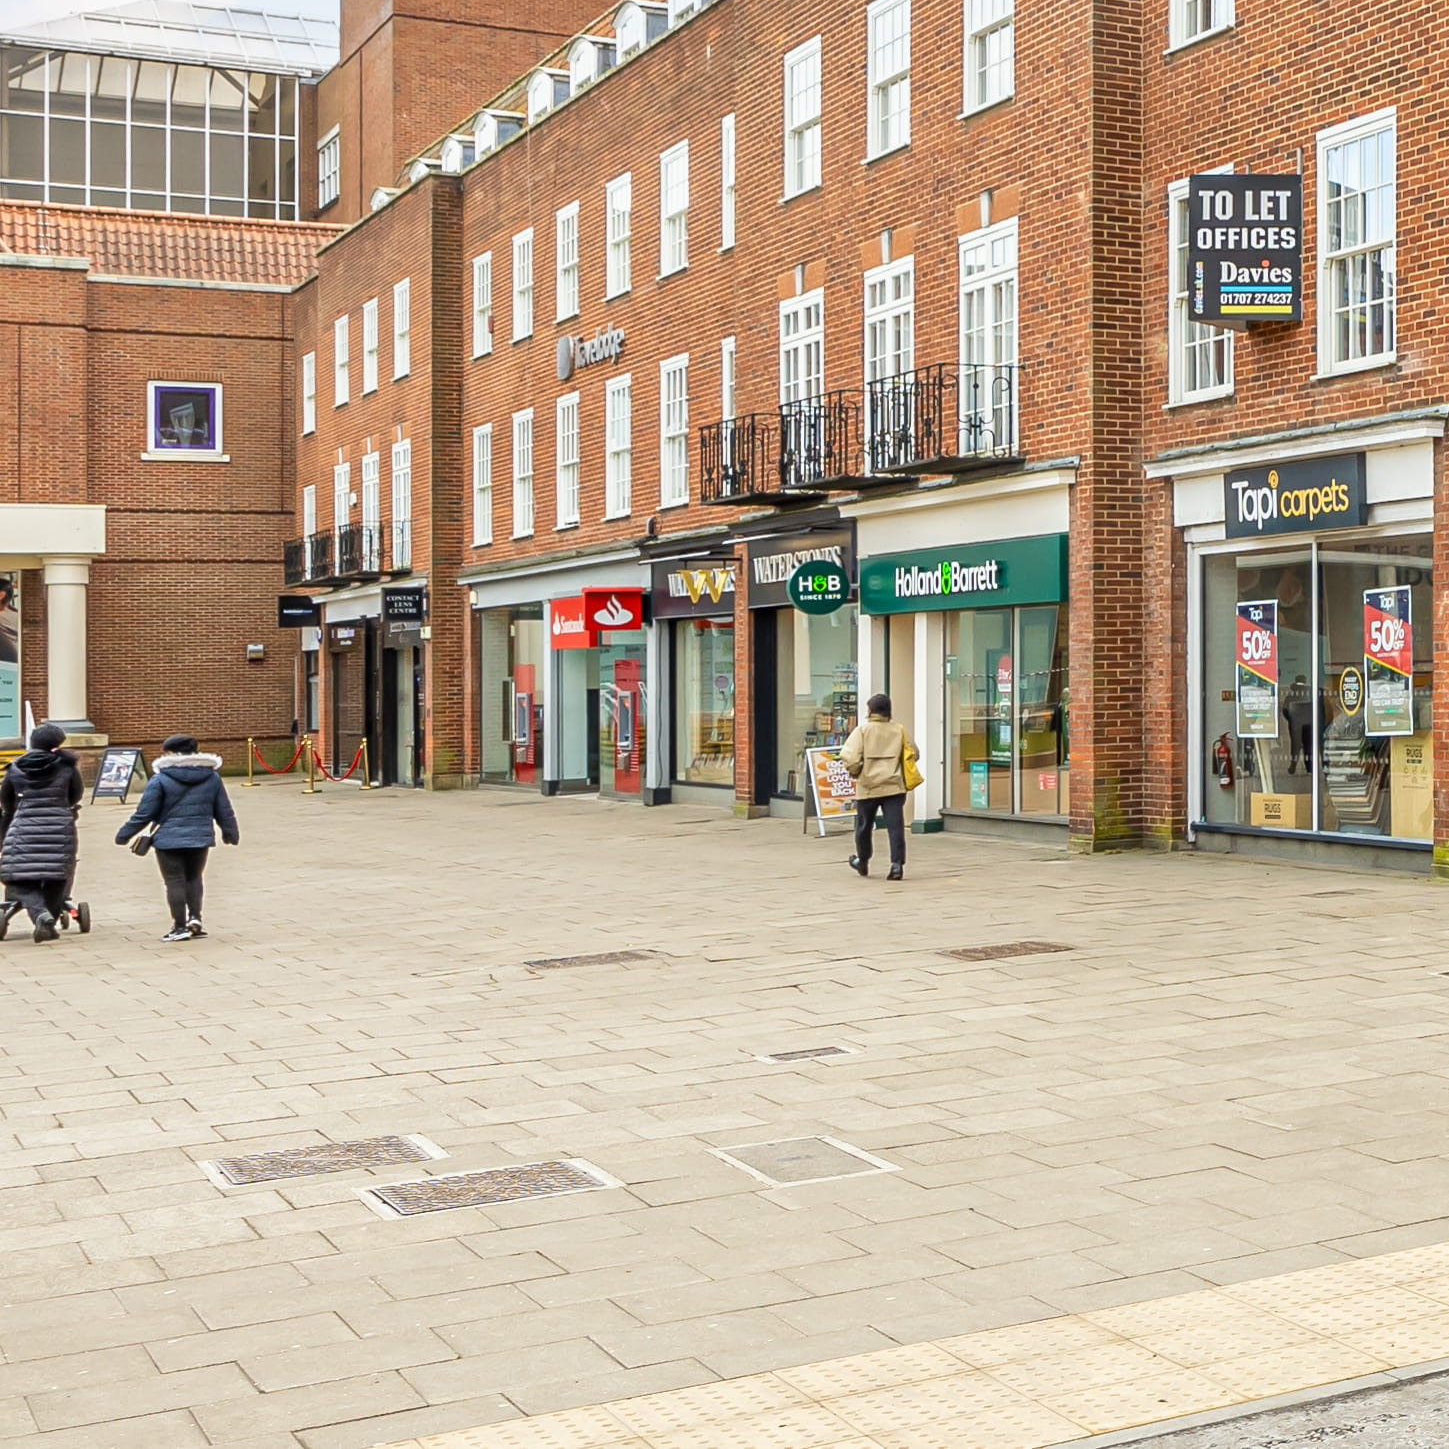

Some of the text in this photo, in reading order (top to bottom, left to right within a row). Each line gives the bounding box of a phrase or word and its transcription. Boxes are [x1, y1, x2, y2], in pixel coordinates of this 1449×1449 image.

[1198, 190, 1292, 221] TO LET
[1197, 227, 1296, 249] OFFICES
[1220, 259, 1293, 283] Davies
[1220, 293, 1293, 305] 01707 274237
[1231, 469, 1350, 531] Tapi carpets
[798, 574, 841, 593] H&B
[386, 595, 420, 603] CONTACT
[1379, 594, 1395, 611] Tapi
[1249, 606, 1264, 622] Tapi
[1242, 630, 1272, 661] 50%
[1370, 619, 1405, 652] 50%
[1264, 803, 1282, 814] RUGS
